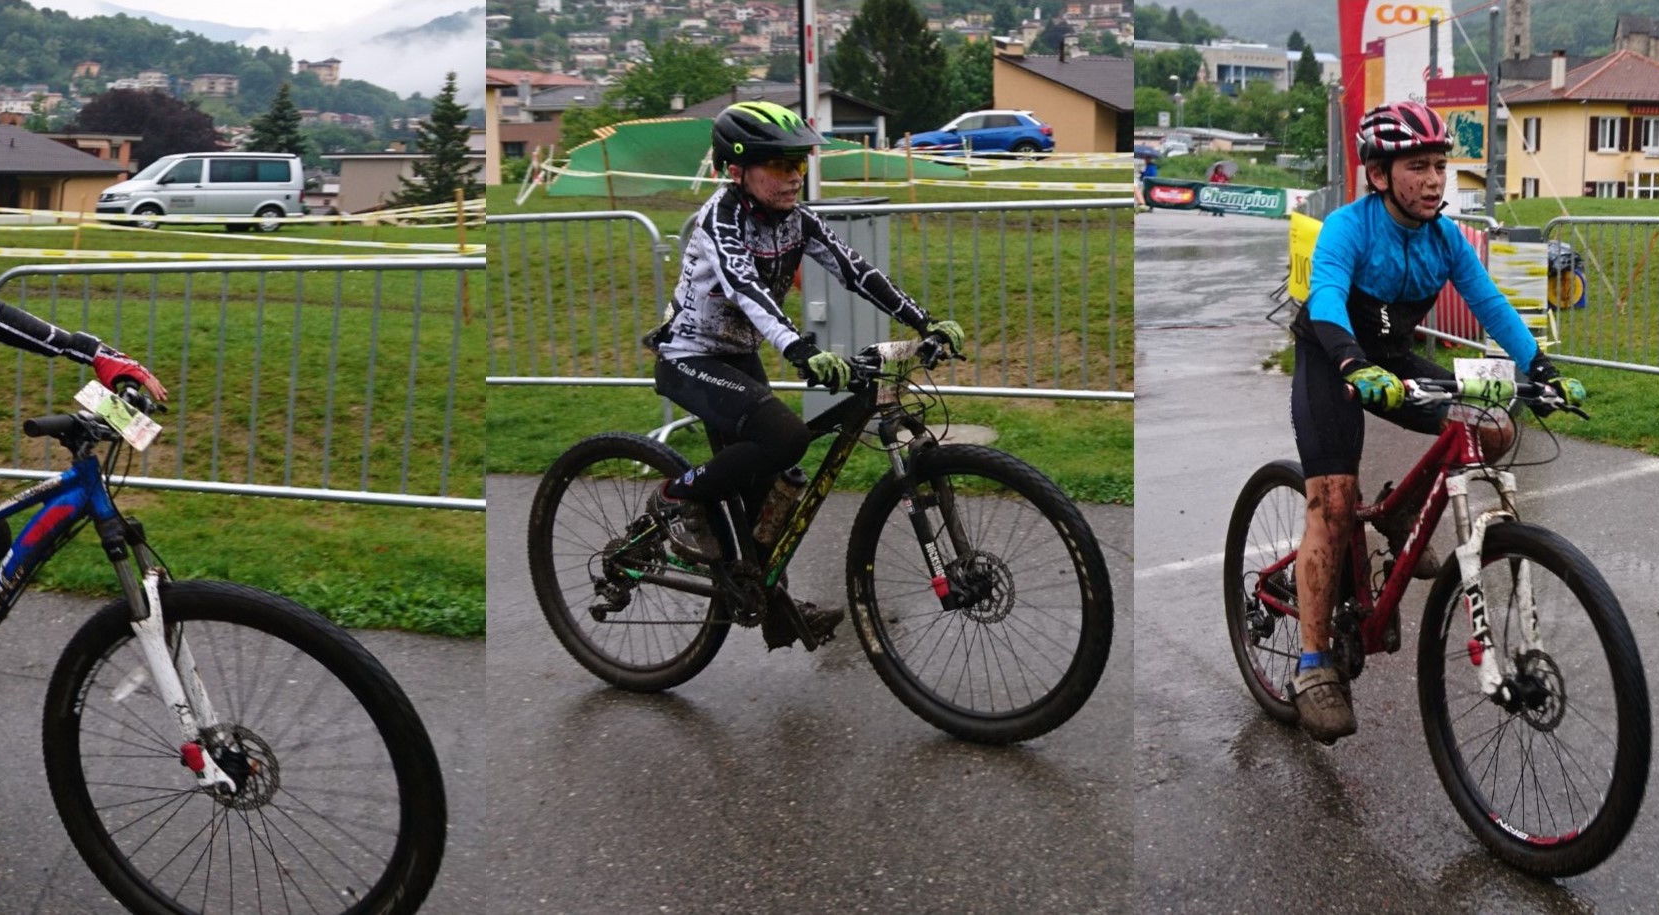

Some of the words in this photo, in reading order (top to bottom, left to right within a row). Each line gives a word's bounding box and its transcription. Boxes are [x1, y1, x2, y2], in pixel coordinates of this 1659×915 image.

[1199, 186, 1279, 210] Champion
[677, 362, 697, 377] Club
[697, 371, 746, 392] Mendrisio
[1480, 380, 1502, 408] 43
